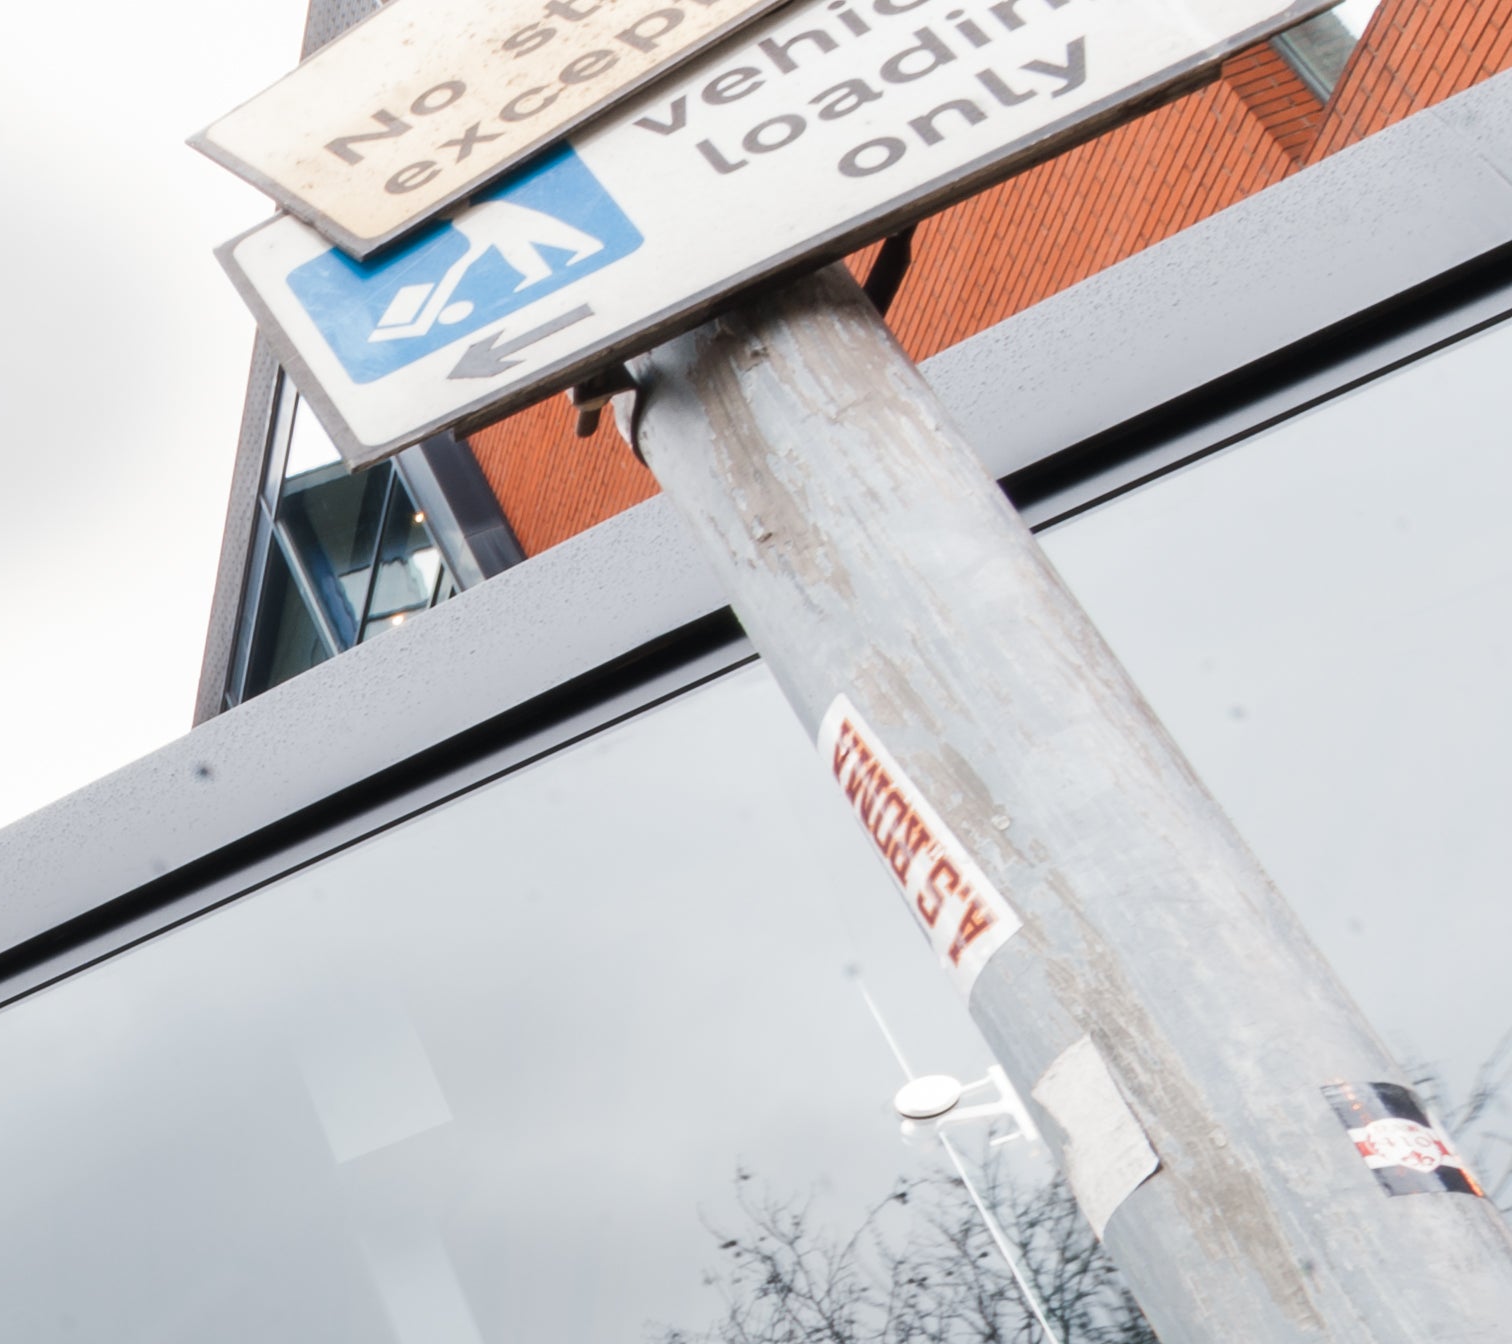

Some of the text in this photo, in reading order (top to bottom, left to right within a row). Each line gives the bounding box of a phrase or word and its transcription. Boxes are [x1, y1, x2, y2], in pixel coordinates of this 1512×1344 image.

[324, 80, 466, 165] No
[384, 0, 726, 195] excep
[838, 36, 1086, 178] only
[833, 717, 931, 888] ROMA
